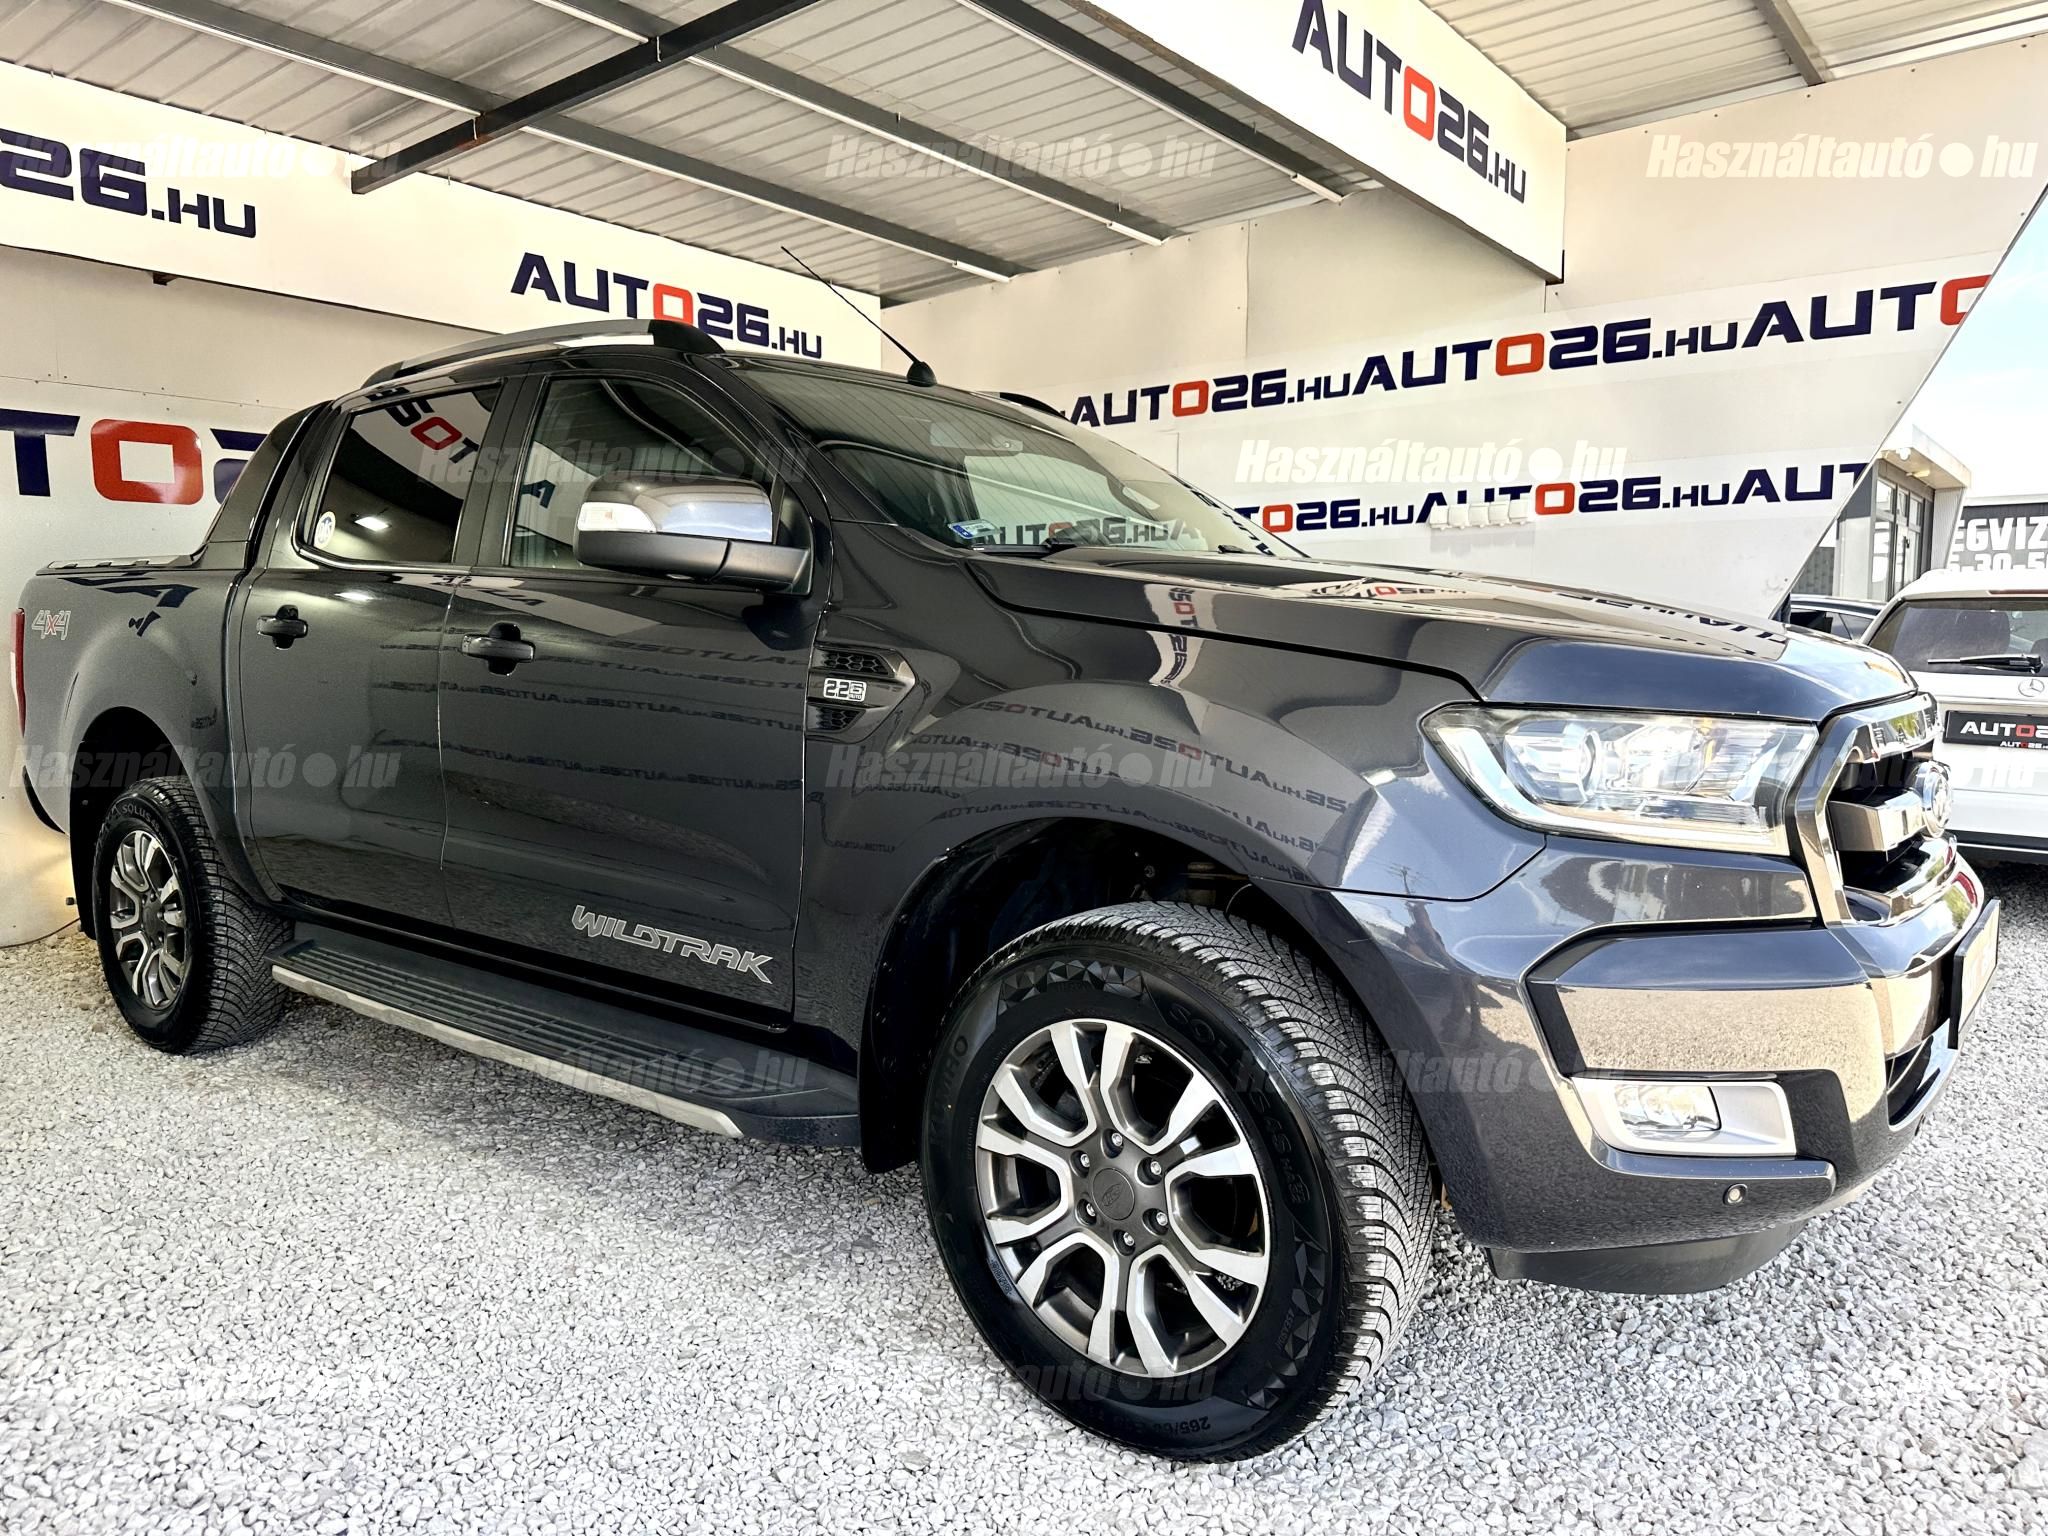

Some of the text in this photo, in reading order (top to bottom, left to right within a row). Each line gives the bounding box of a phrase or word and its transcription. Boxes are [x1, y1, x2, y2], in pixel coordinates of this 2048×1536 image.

[1293, 0, 1526, 204] AUTO26.HU
[510, 252, 823, 359] AUTO26.HU
[571, 905, 774, 985] WILDTRAK
